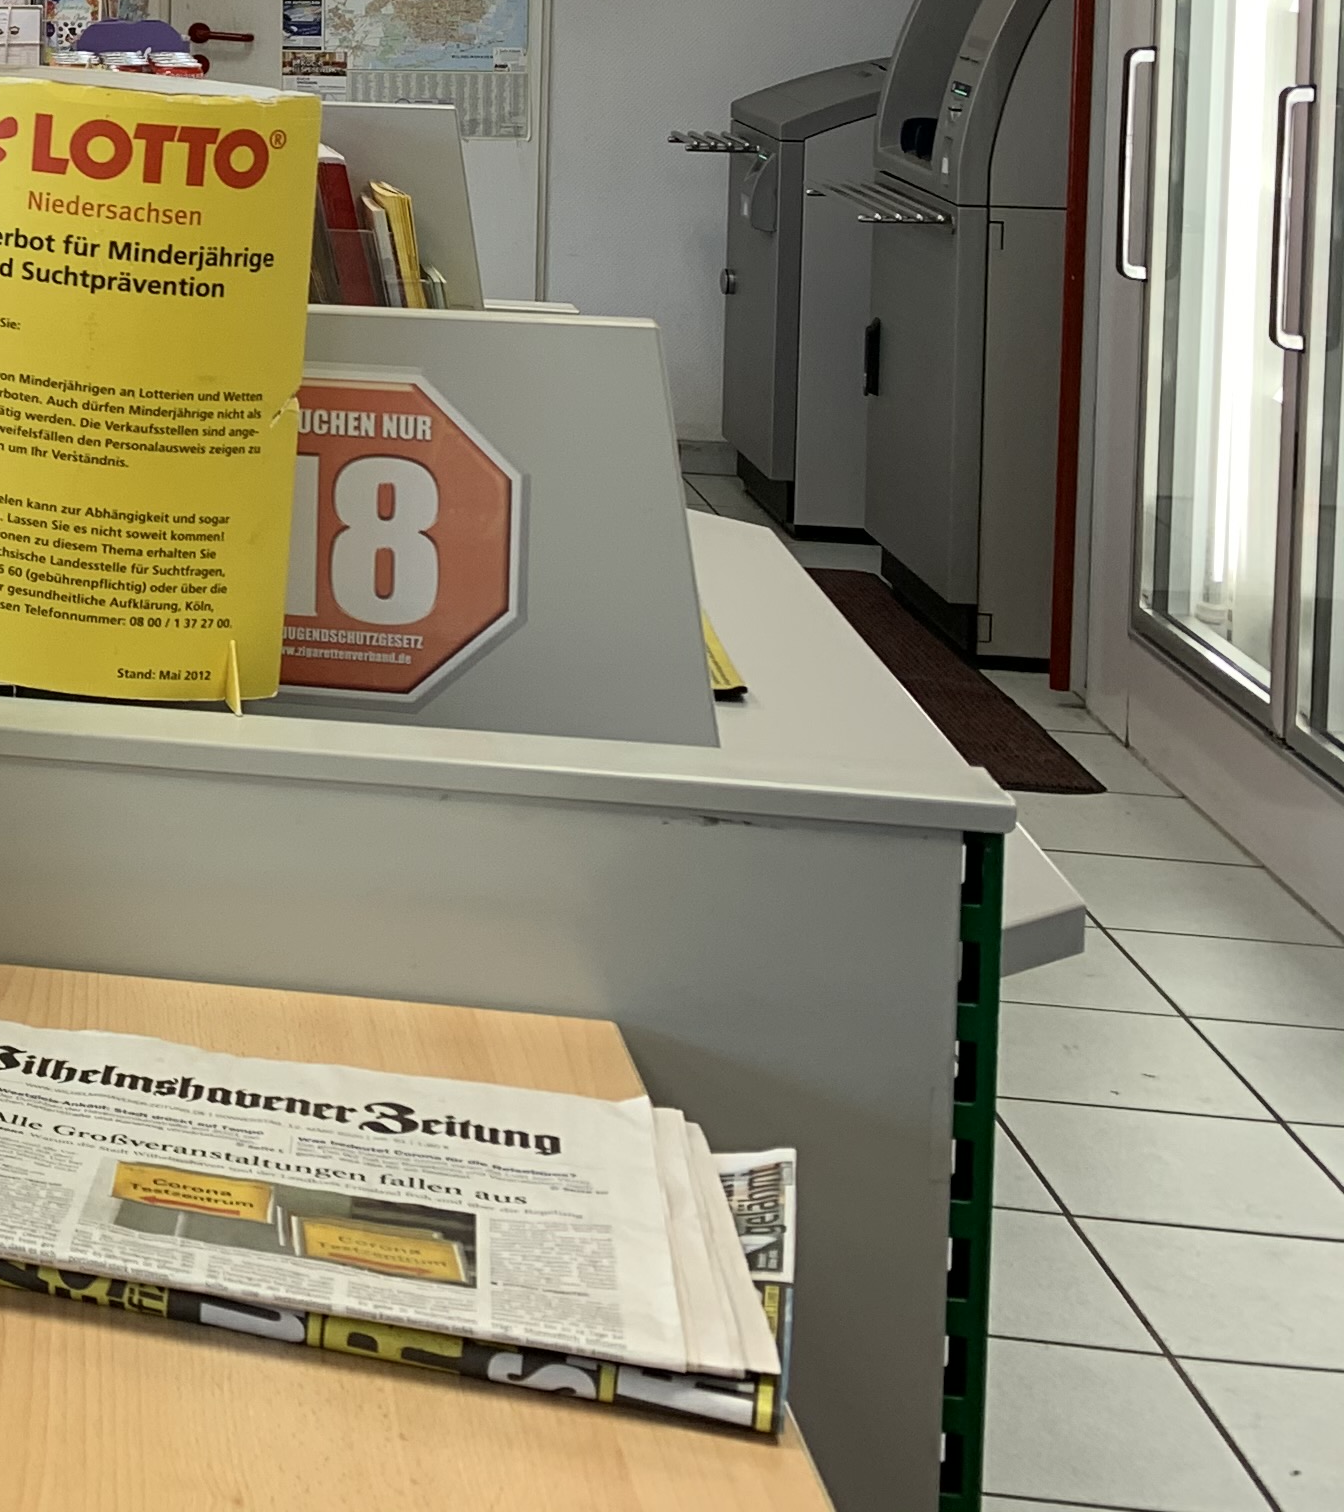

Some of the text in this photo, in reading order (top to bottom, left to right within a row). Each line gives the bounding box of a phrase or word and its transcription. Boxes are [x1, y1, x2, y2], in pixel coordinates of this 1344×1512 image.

[31, 113, 270, 189] LOTTO
[27, 190, 202, 226] Niedersachsen
[62, 234, 101, 259] für
[108, 240, 274, 272] Minderjährige
[21, 260, 226, 299] Suchtprävention
[19, 373, 116, 396] Minderjährigen
[119, 388, 135, 398] an
[139, 387, 195, 402] Lotterien
[197, 391, 220, 401] und
[223, 391, 263, 402] Wetten
[382, 414, 432, 441] NUR
[117, 668, 211, 681] Stand: Mai 2012
[358, 1102, 564, 1156] Zeitung
[53, 1123, 367, 1184] Großveranstaltungen
[378, 1173, 463, 1196] fallen
[474, 1190, 528, 1205] aus
[129, 1182, 256, 1209] Testzentrum
[152, 1176, 233, 1197] Corona
[337, 1234, 422, 1256] Corona
